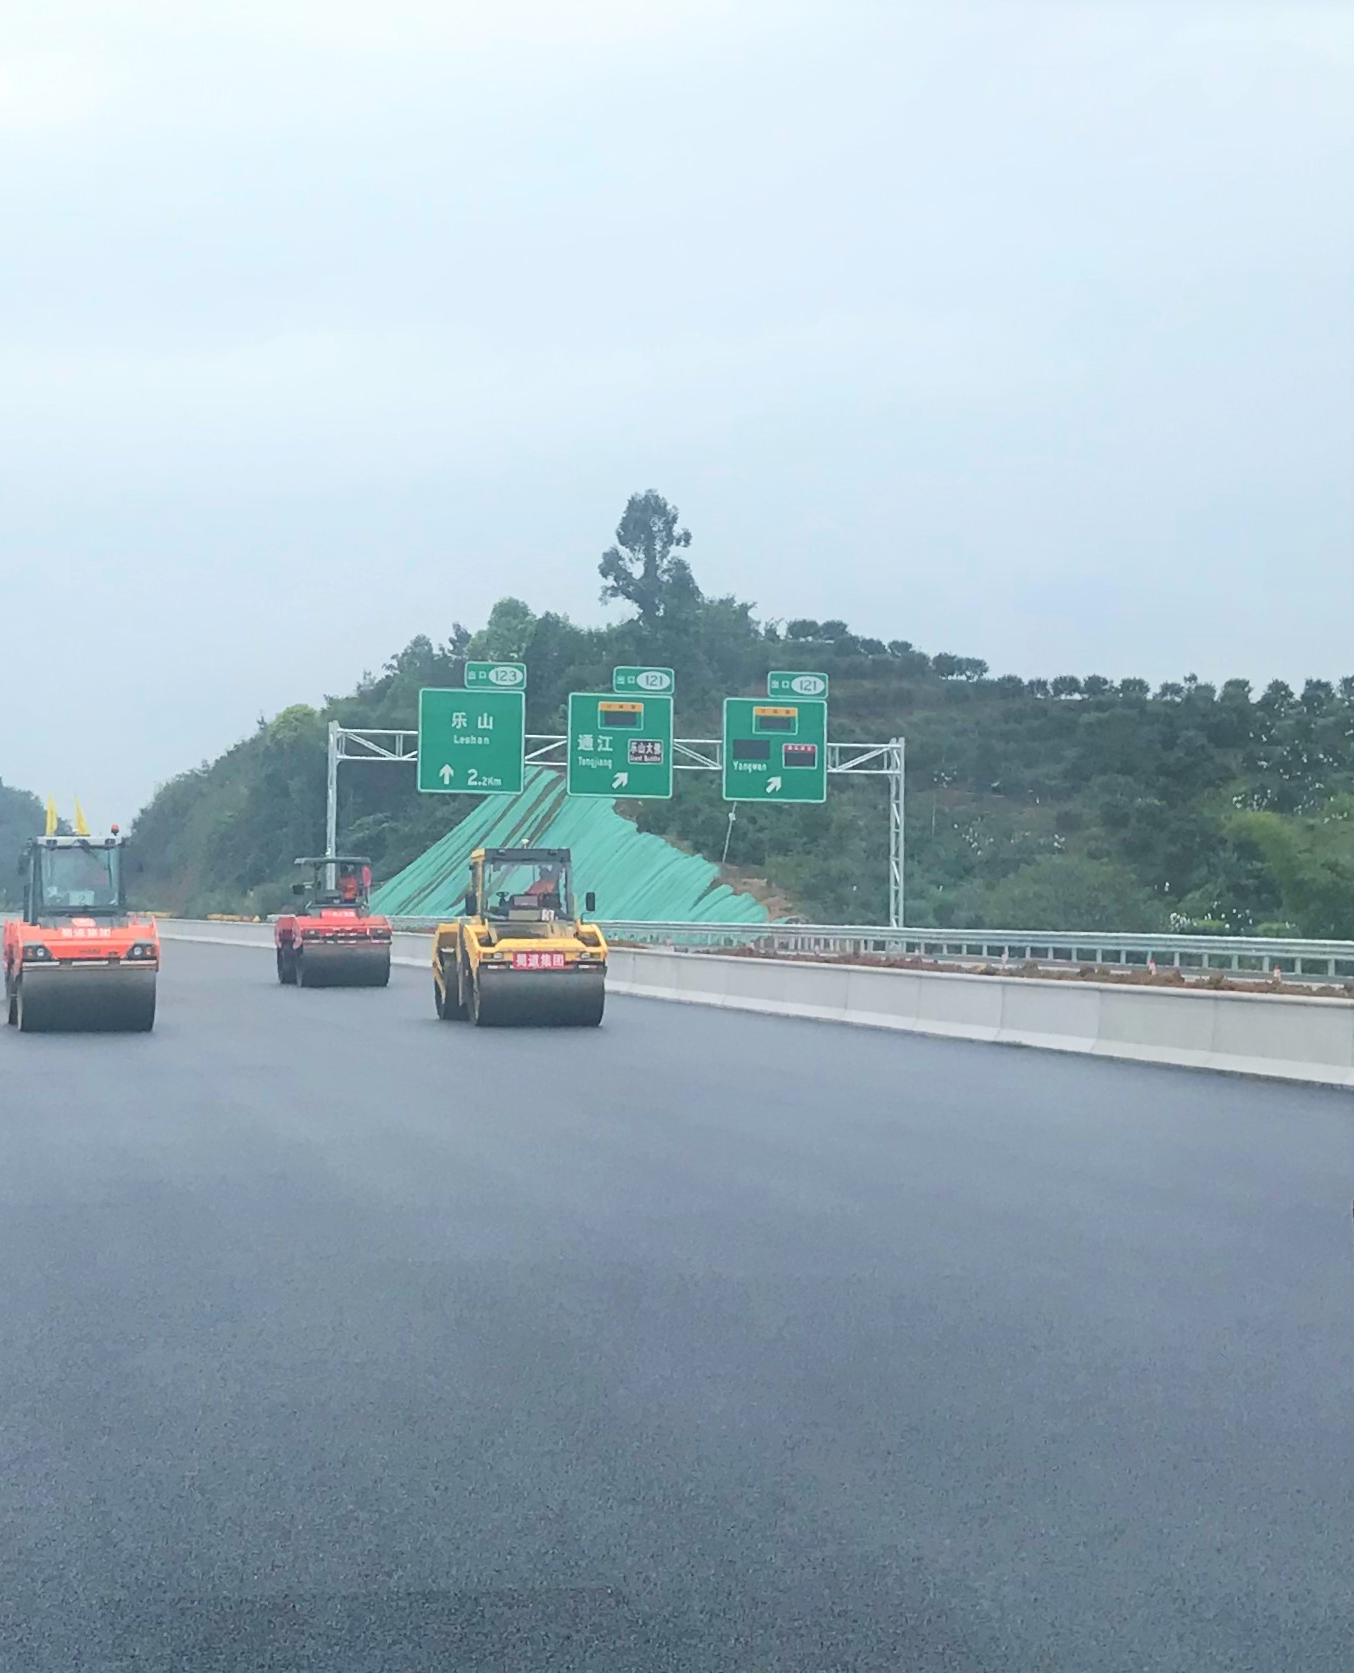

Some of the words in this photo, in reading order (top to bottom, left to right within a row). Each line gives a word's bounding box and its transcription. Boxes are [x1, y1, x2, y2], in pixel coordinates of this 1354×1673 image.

[494, 670, 517, 681] 123
[645, 675, 663, 687] 121
[799, 680, 817, 691] 121
[451, 712, 494, 730] 乐山
[453, 734, 491, 745] Leshan
